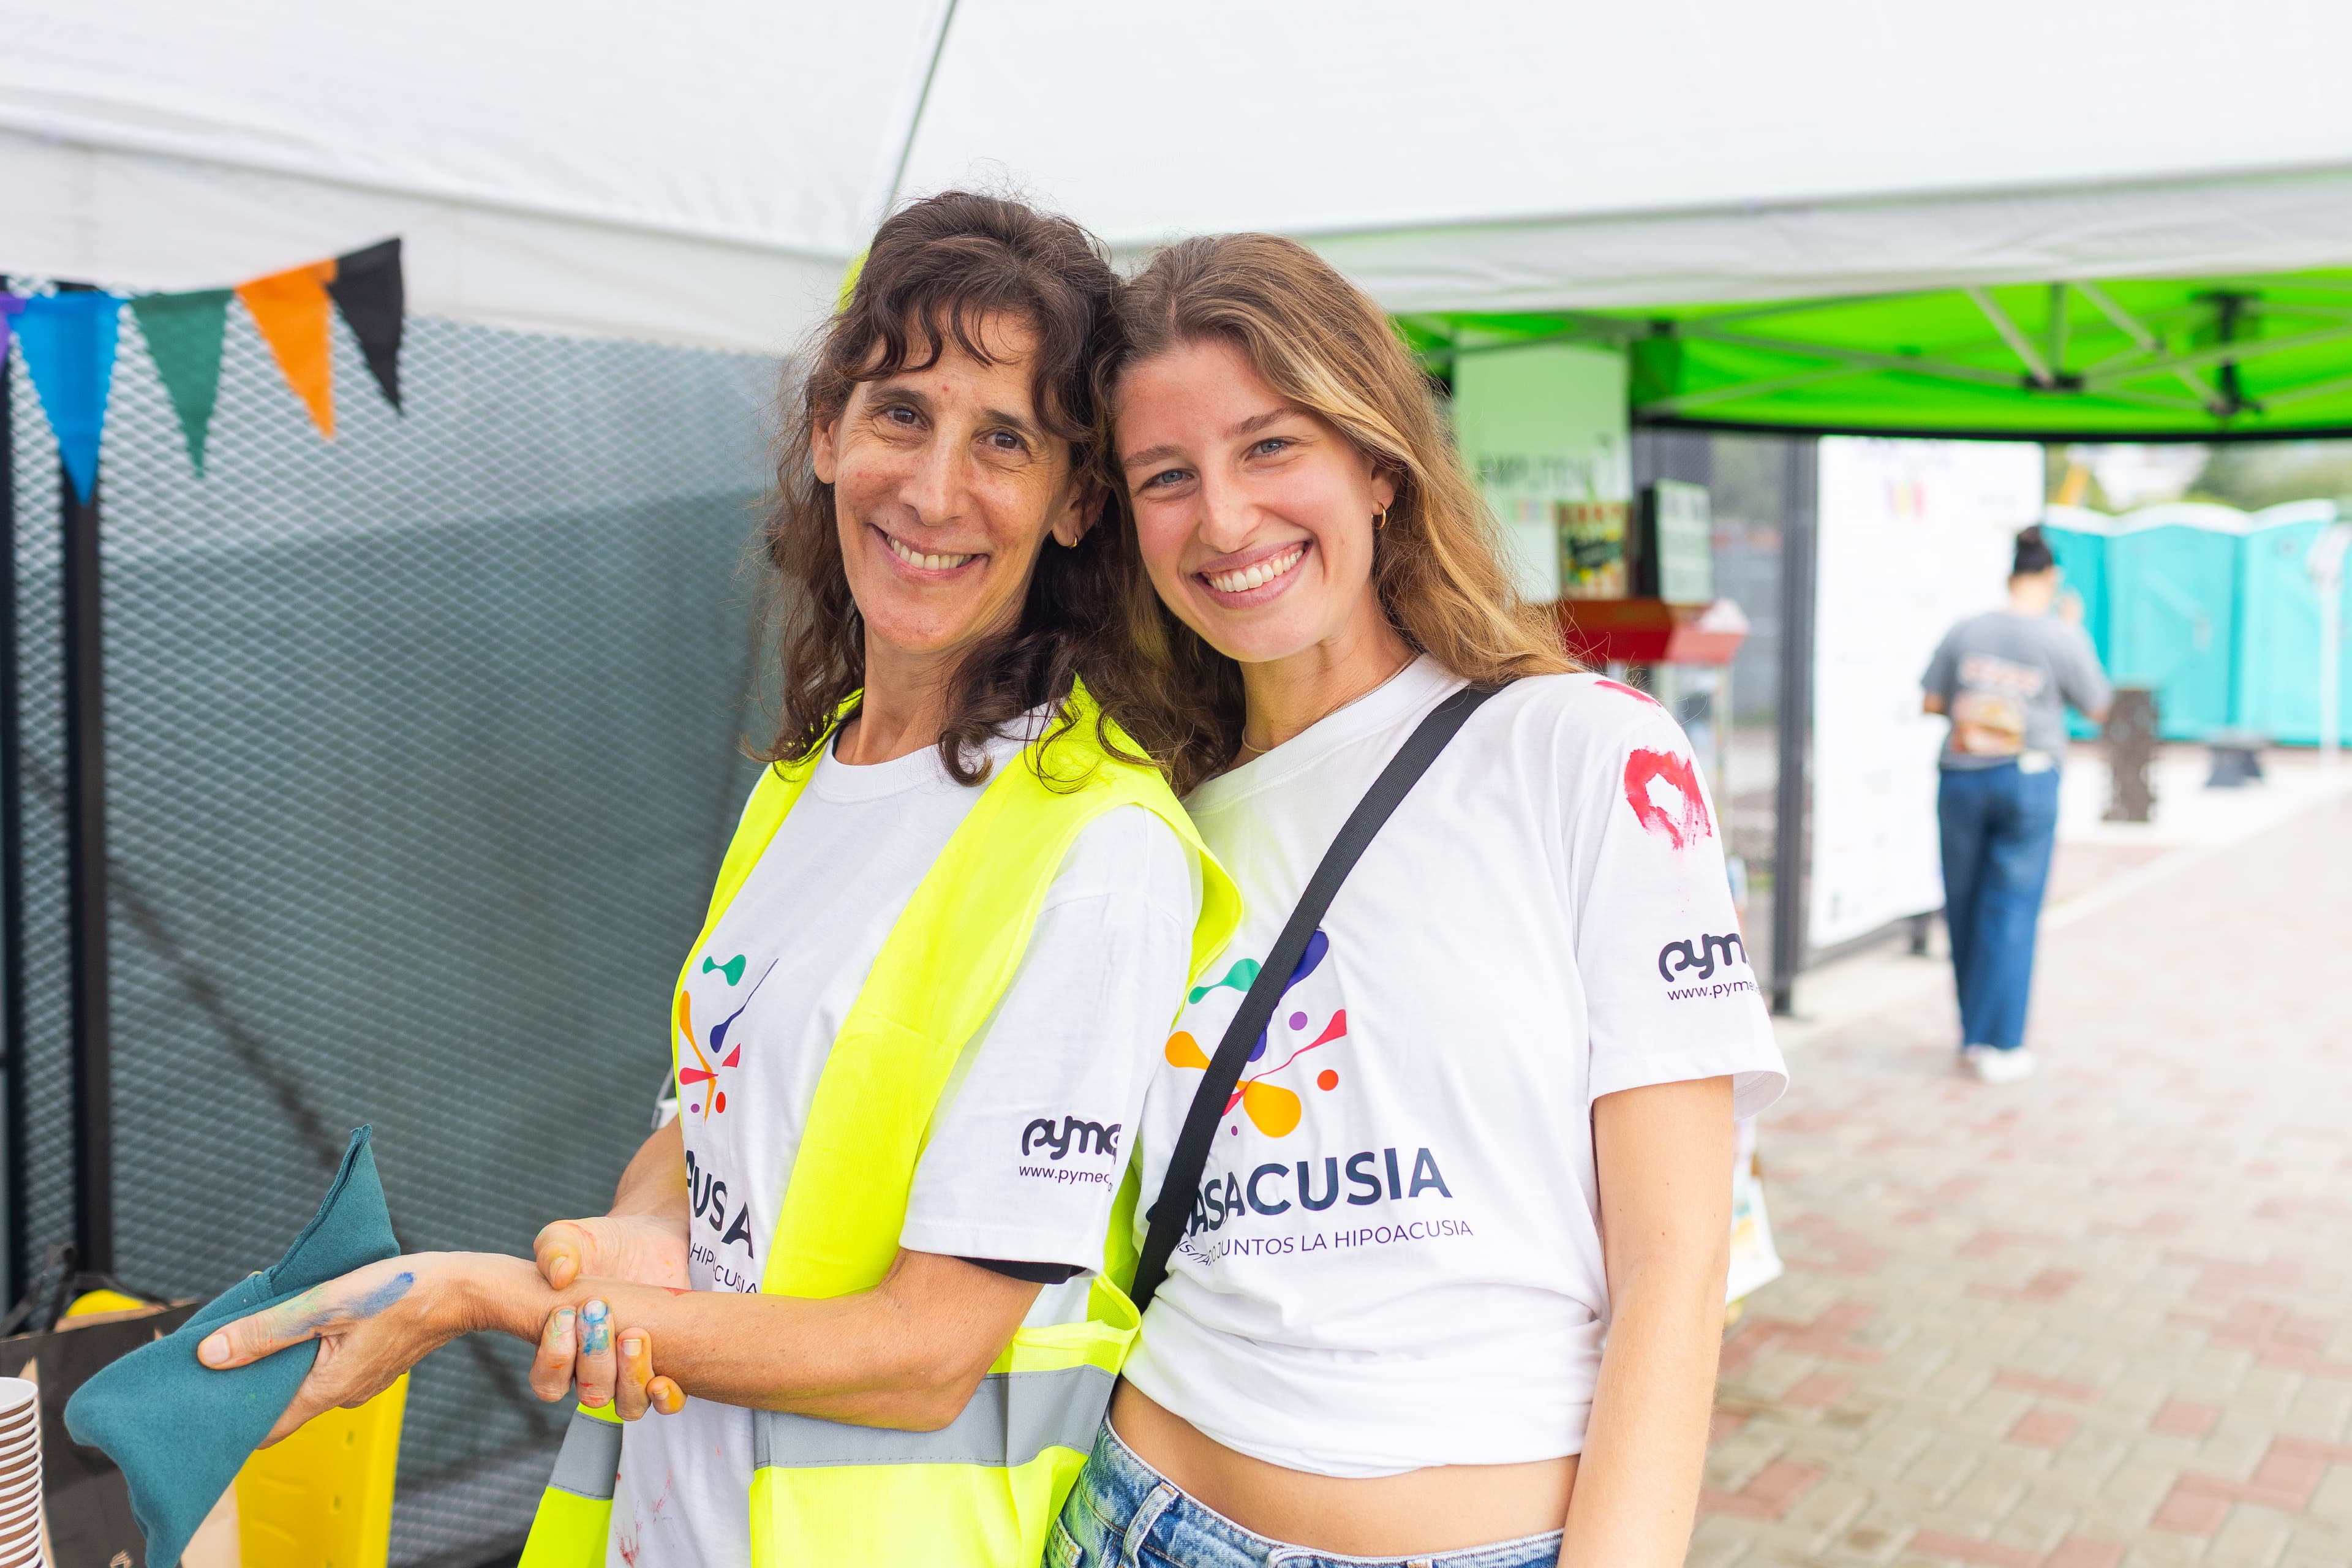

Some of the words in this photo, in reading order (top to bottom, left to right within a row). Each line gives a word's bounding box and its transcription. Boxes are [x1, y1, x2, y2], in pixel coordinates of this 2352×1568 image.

[1658, 933, 1751, 982] pym
[1145, 1147, 1453, 1237] ASACUSIA
[1217, 1237, 1294, 1259] JUNTOS
[1302, 1234, 1327, 1251] LA
[1335, 1220, 1474, 1248] HIPOACUSIA
